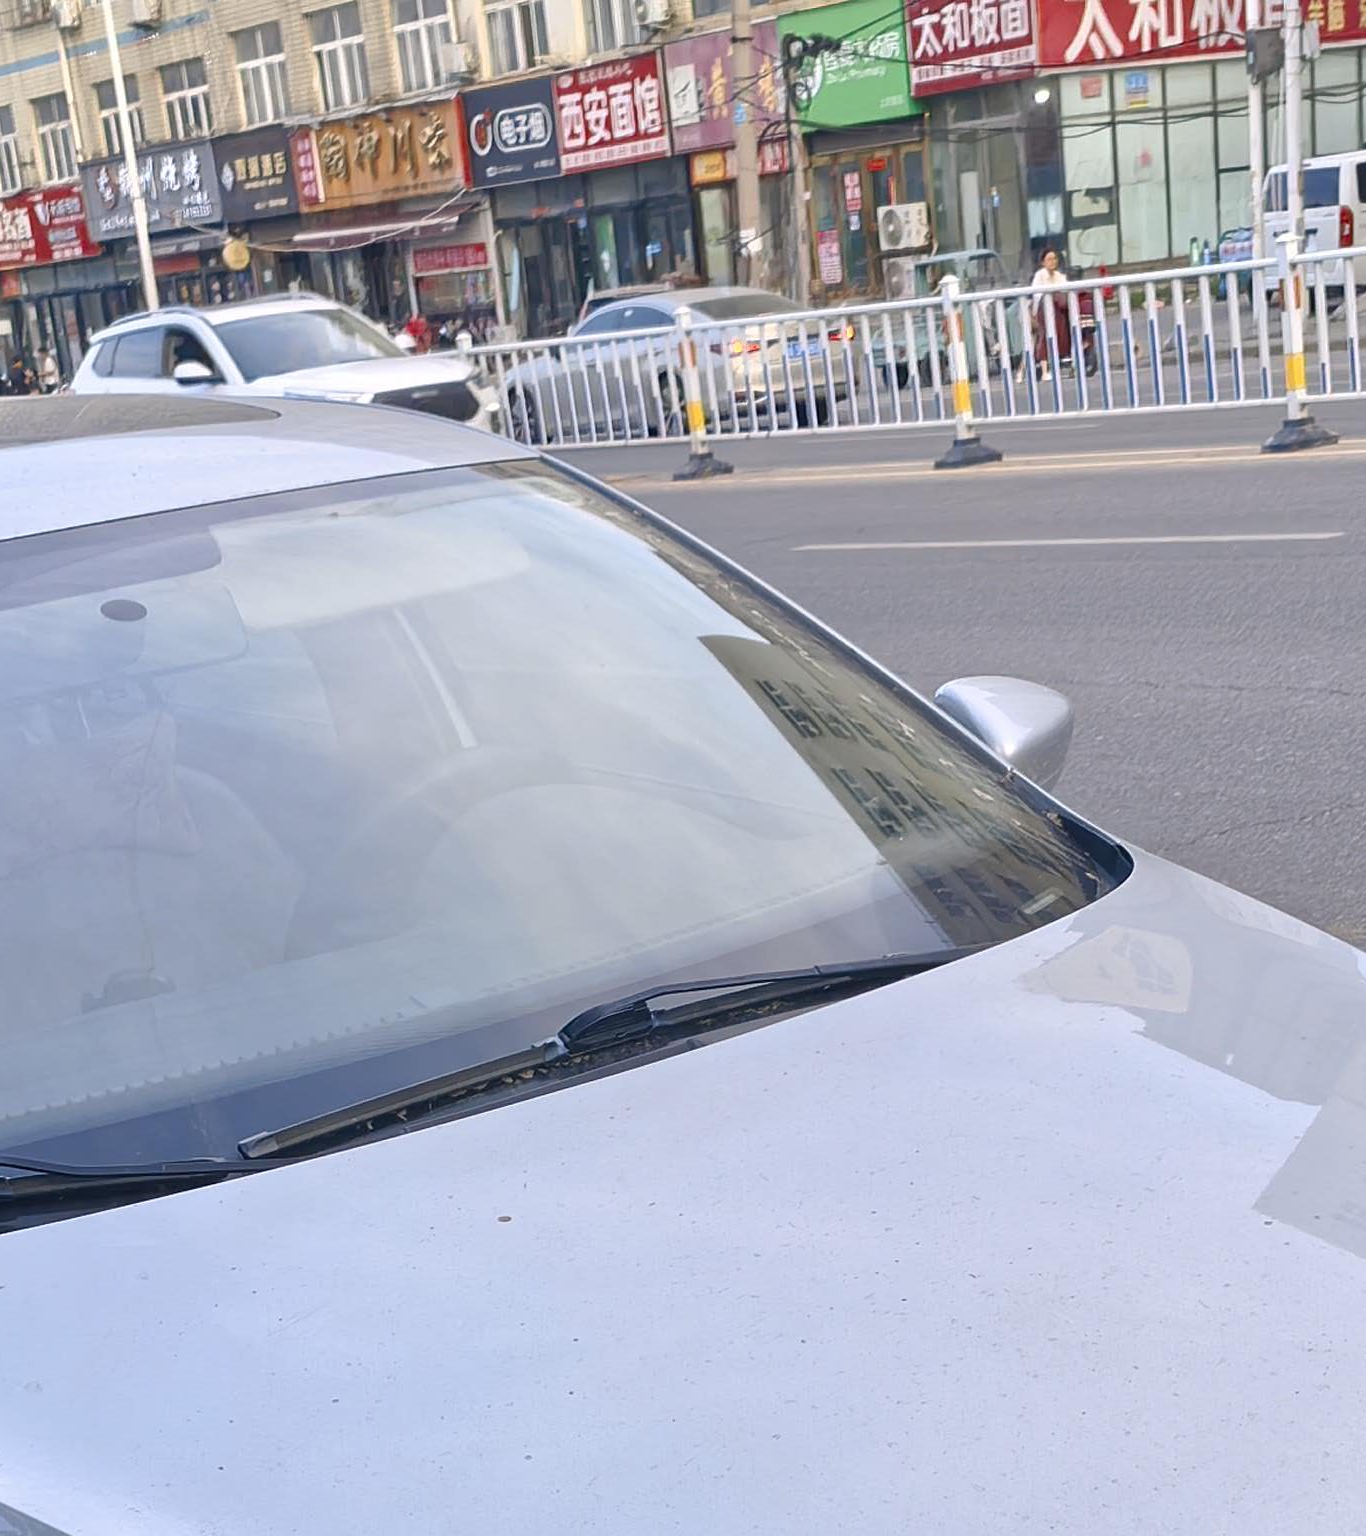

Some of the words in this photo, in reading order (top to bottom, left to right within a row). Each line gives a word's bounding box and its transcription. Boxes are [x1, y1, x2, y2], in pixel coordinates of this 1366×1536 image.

[912, 0, 1029, 59] 太和板面
[559, 75, 662, 149] 西安面馆
